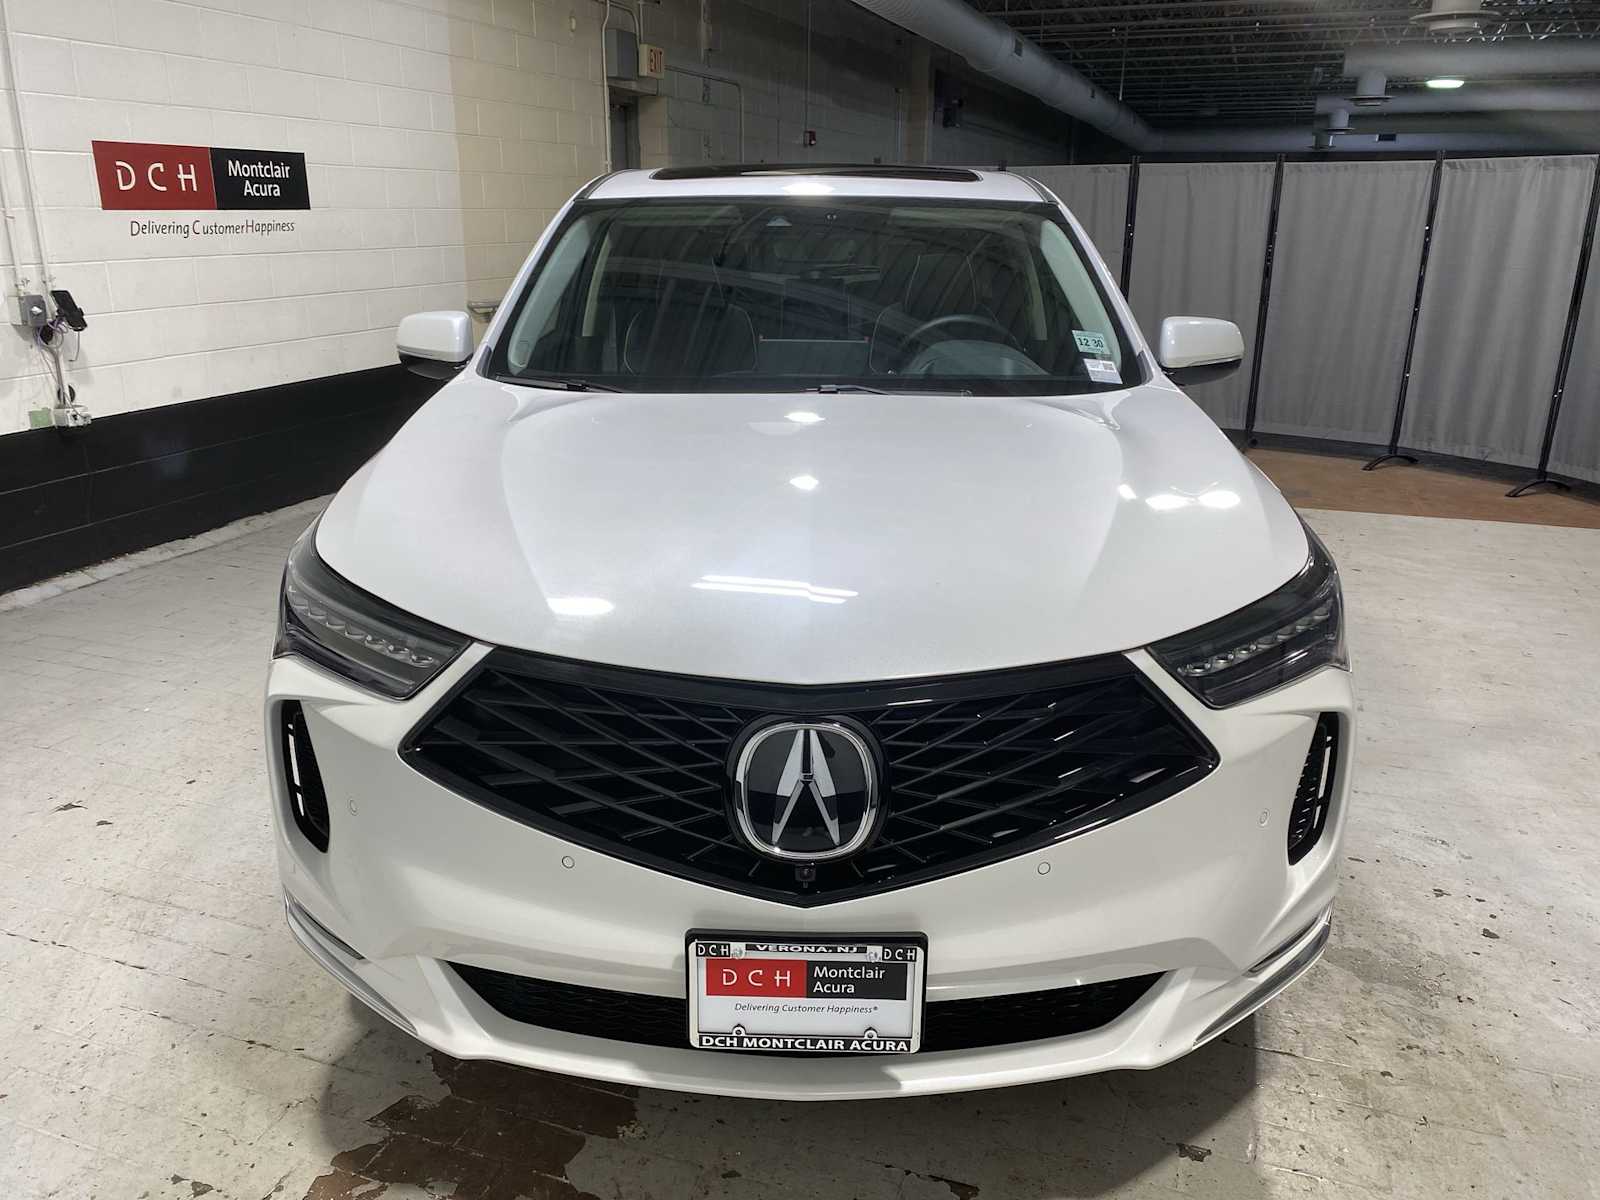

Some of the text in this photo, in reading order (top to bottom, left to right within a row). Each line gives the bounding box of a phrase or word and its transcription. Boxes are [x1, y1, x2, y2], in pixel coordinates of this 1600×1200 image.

[649, 49, 663, 72] EXIT
[227, 159, 291, 179] Montclair
[243, 180, 281, 197] Acura
[130, 220, 190, 238] Delivering
[245, 219, 295, 236] Happiness
[1077, 337, 1090, 347] 12
[813, 966, 885, 979] Montclair
[813, 982, 855, 993] Acura
[735, 1003, 780, 1013] Delivering
[782, 1004, 825, 1013] Customer
[702, 1036, 908, 1051] DCH MONTCLAIR ACURA
